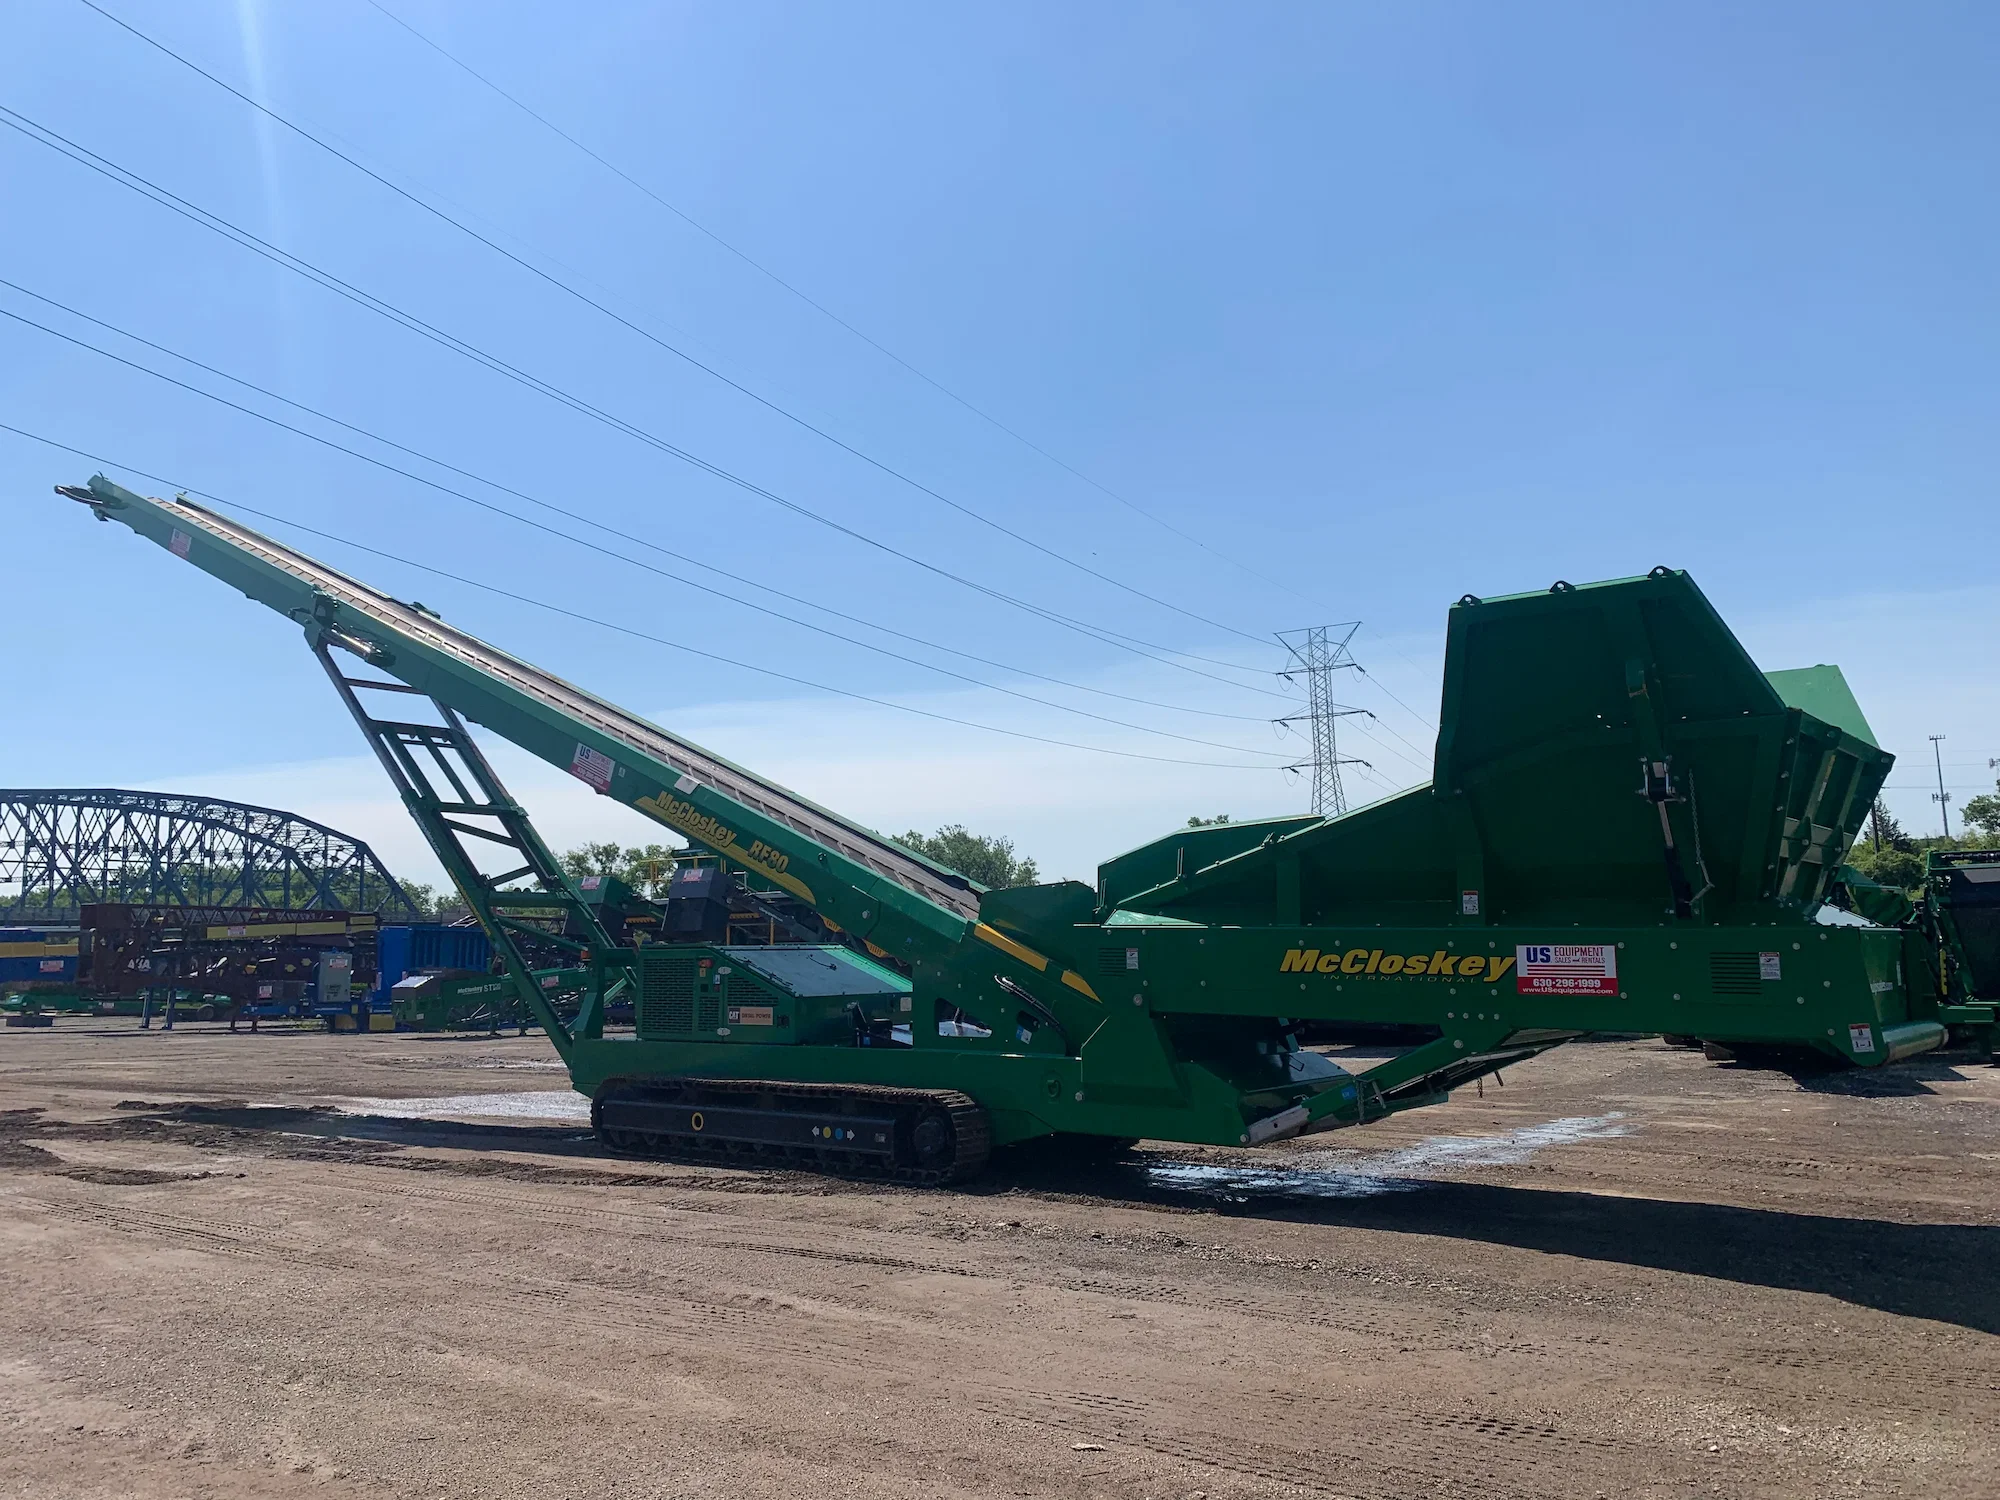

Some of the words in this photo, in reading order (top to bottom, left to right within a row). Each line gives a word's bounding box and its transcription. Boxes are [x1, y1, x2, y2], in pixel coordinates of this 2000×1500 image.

[655, 791, 737, 848] McCloskey
[747, 840, 789, 873] RF80
[1526, 947, 1551, 963] US
[1554, 947, 1604, 956] EQUIPMENT
[1280, 949, 1516, 982] McCloskey
[1323, 975, 1476, 983] INTERNATIONAL
[729, 1011, 740, 1019] CAT
